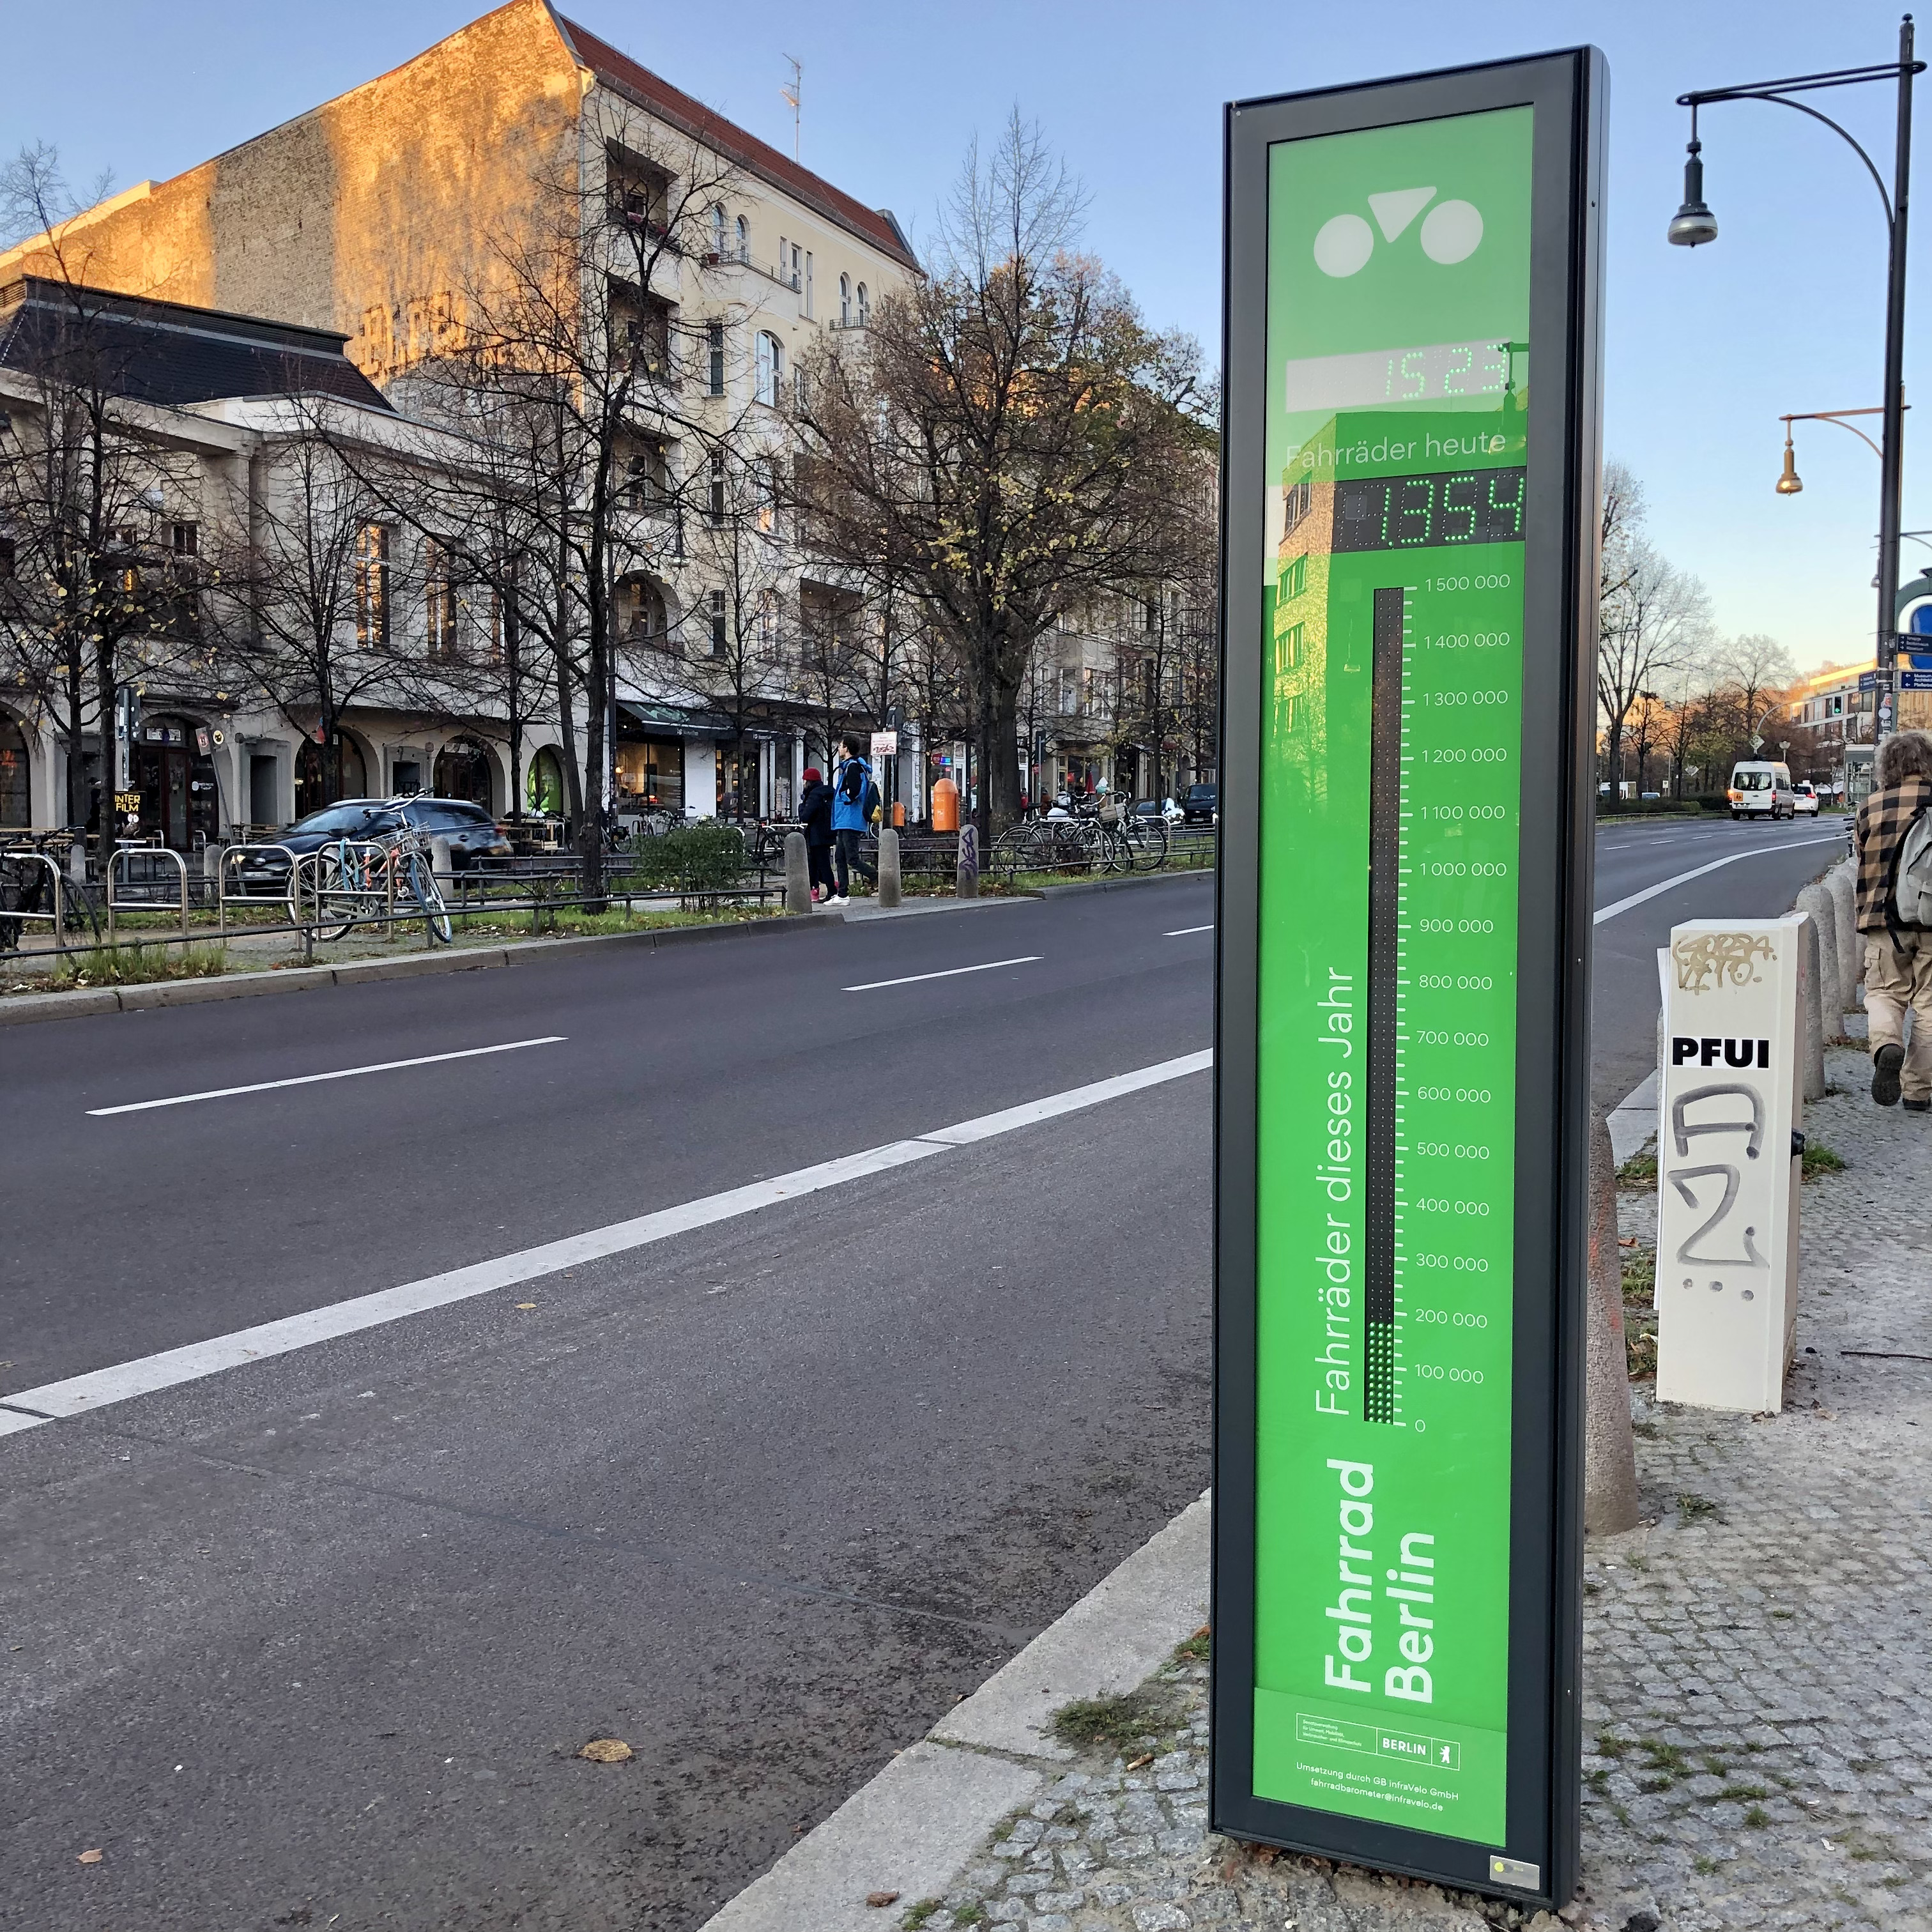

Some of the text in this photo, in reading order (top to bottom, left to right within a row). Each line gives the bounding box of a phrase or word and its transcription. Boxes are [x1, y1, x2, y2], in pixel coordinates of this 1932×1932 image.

[1386, 344, 1507, 399] 15 23
[1286, 431, 1506, 469] Fahrräder heute
[1475, 574, 1510, 589] 000
[1474, 632, 1510, 647] 000
[1473, 690, 1508, 705] 000
[1471, 747, 1507, 762] 000
[114, 793, 141, 804] INTER
[116, 803, 139, 813] FILM
[1469, 806, 1505, 819] 000
[1471, 862, 1506, 877] 000
[1420, 919, 1494, 933] 900 000
[1419, 974, 1492, 990] 800 000
[1416, 1030, 1489, 1046] 700 000
[1672, 1037, 1770, 1069] PFUI
[1418, 1086, 1491, 1103] 600 000
[1417, 1142, 1490, 1160] 500 000
[1314, 967, 1354, 1416] Fahrräder dieses Jahr
[1416, 1197, 1489, 1216] 400 000
[1416, 1253, 1489, 1272] 300 000
[1415, 1308, 1487, 1328] 200 000
[1414, 1363, 1484, 1384] 100 000
[1414, 1419, 1425, 1432] 0
[1324, 1458, 1374, 1693] Fahrrad
[1384, 1532, 1434, 1704] Berlin
[1382, 1737, 1426, 1756] BERLIN
[1296, 1761, 1459, 1801] Umsetzung durch GB infraVelo GmbH
[1310, 1777, 1443, 1812] fahrradbarometer@infravelo.de
